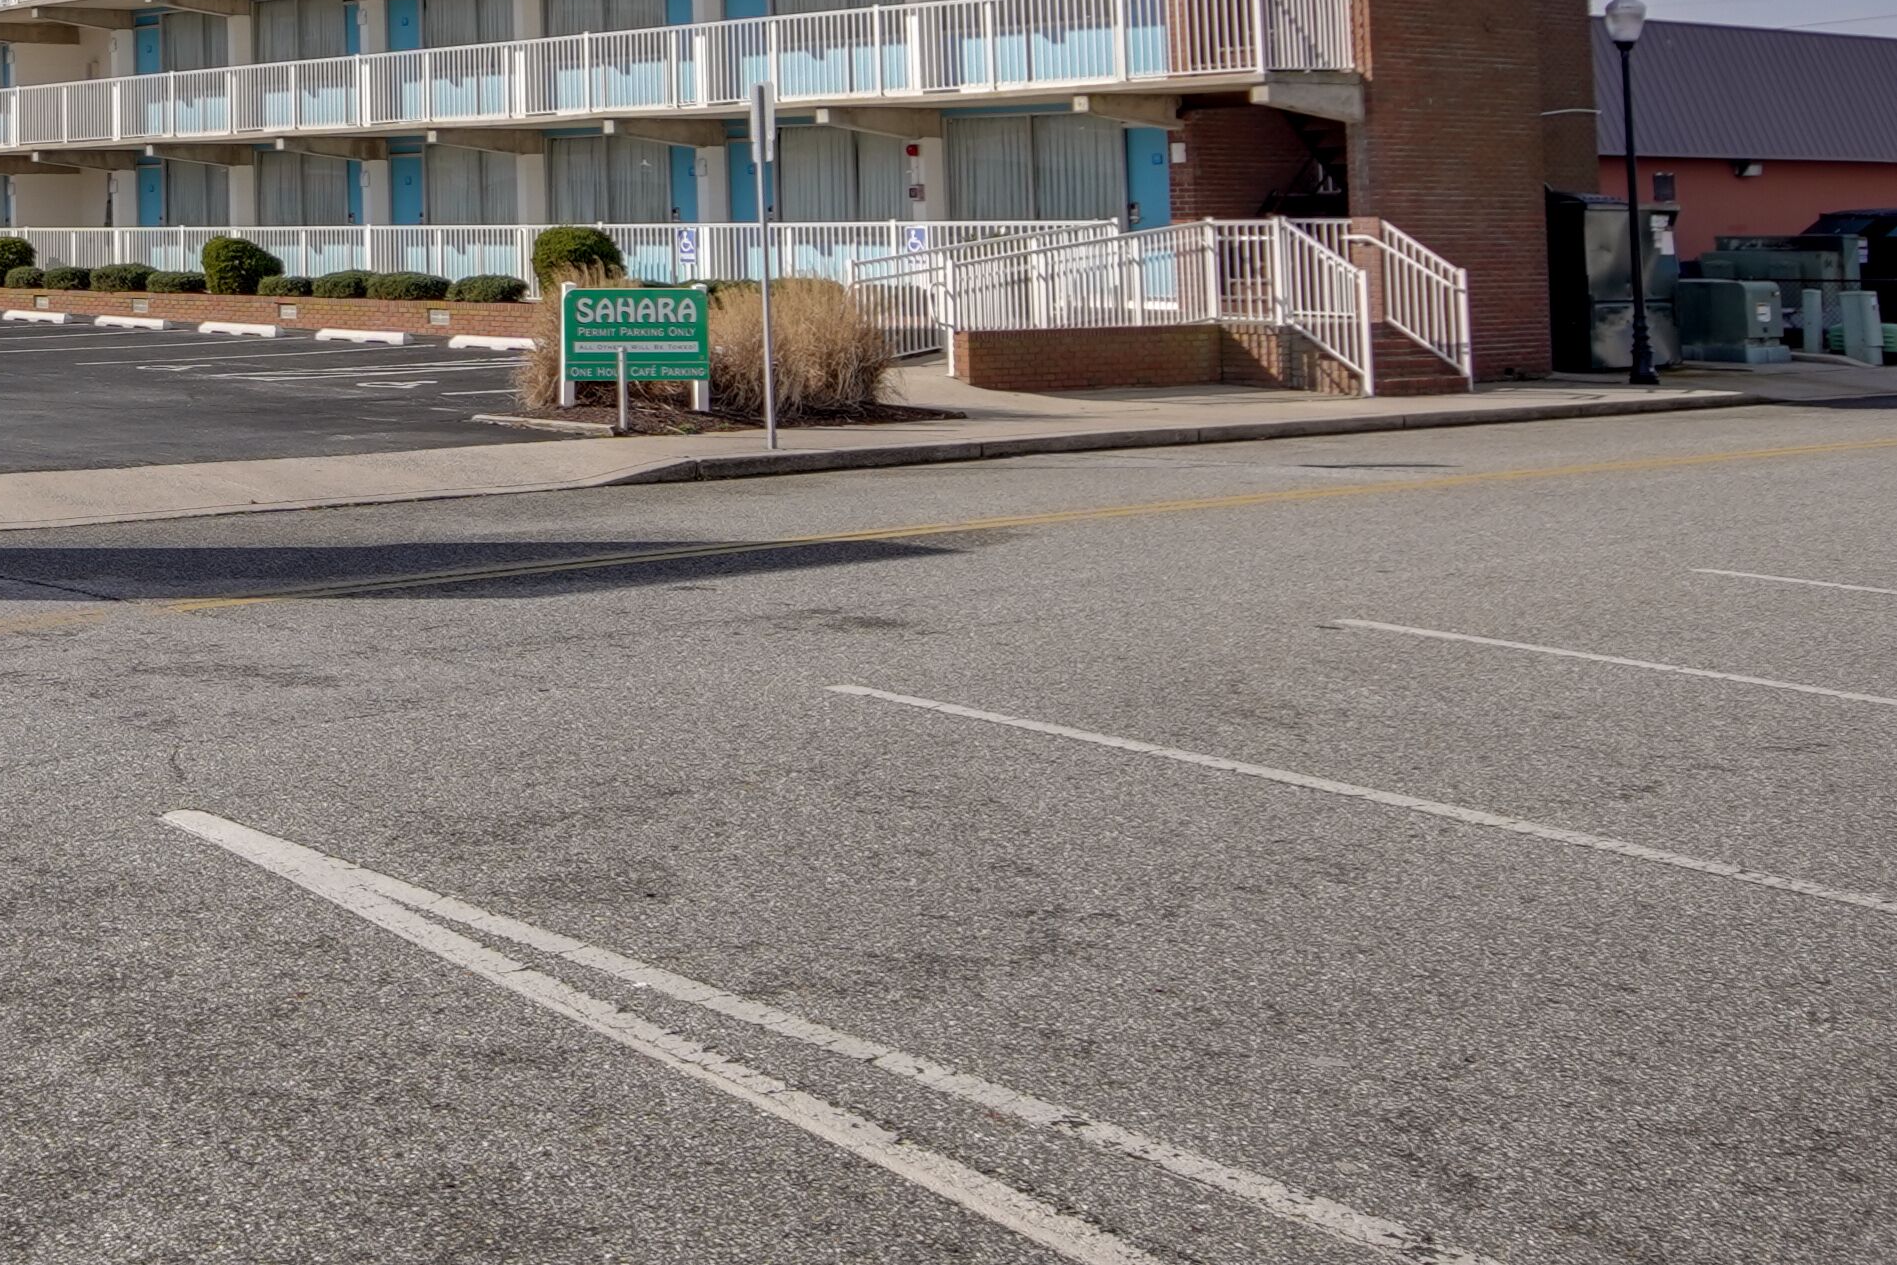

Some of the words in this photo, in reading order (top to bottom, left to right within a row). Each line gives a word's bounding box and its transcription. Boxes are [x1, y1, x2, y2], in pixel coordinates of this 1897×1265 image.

[576, 297, 697, 324] SAHARA
[577, 327, 616, 337] PERMIT
[619, 327, 664, 337] PARKING
[668, 327, 696, 337] ONLY
[571, 367, 592, 377] ONE
[630, 364, 656, 377] CAFÉ
[661, 367, 705, 377] PARKING
